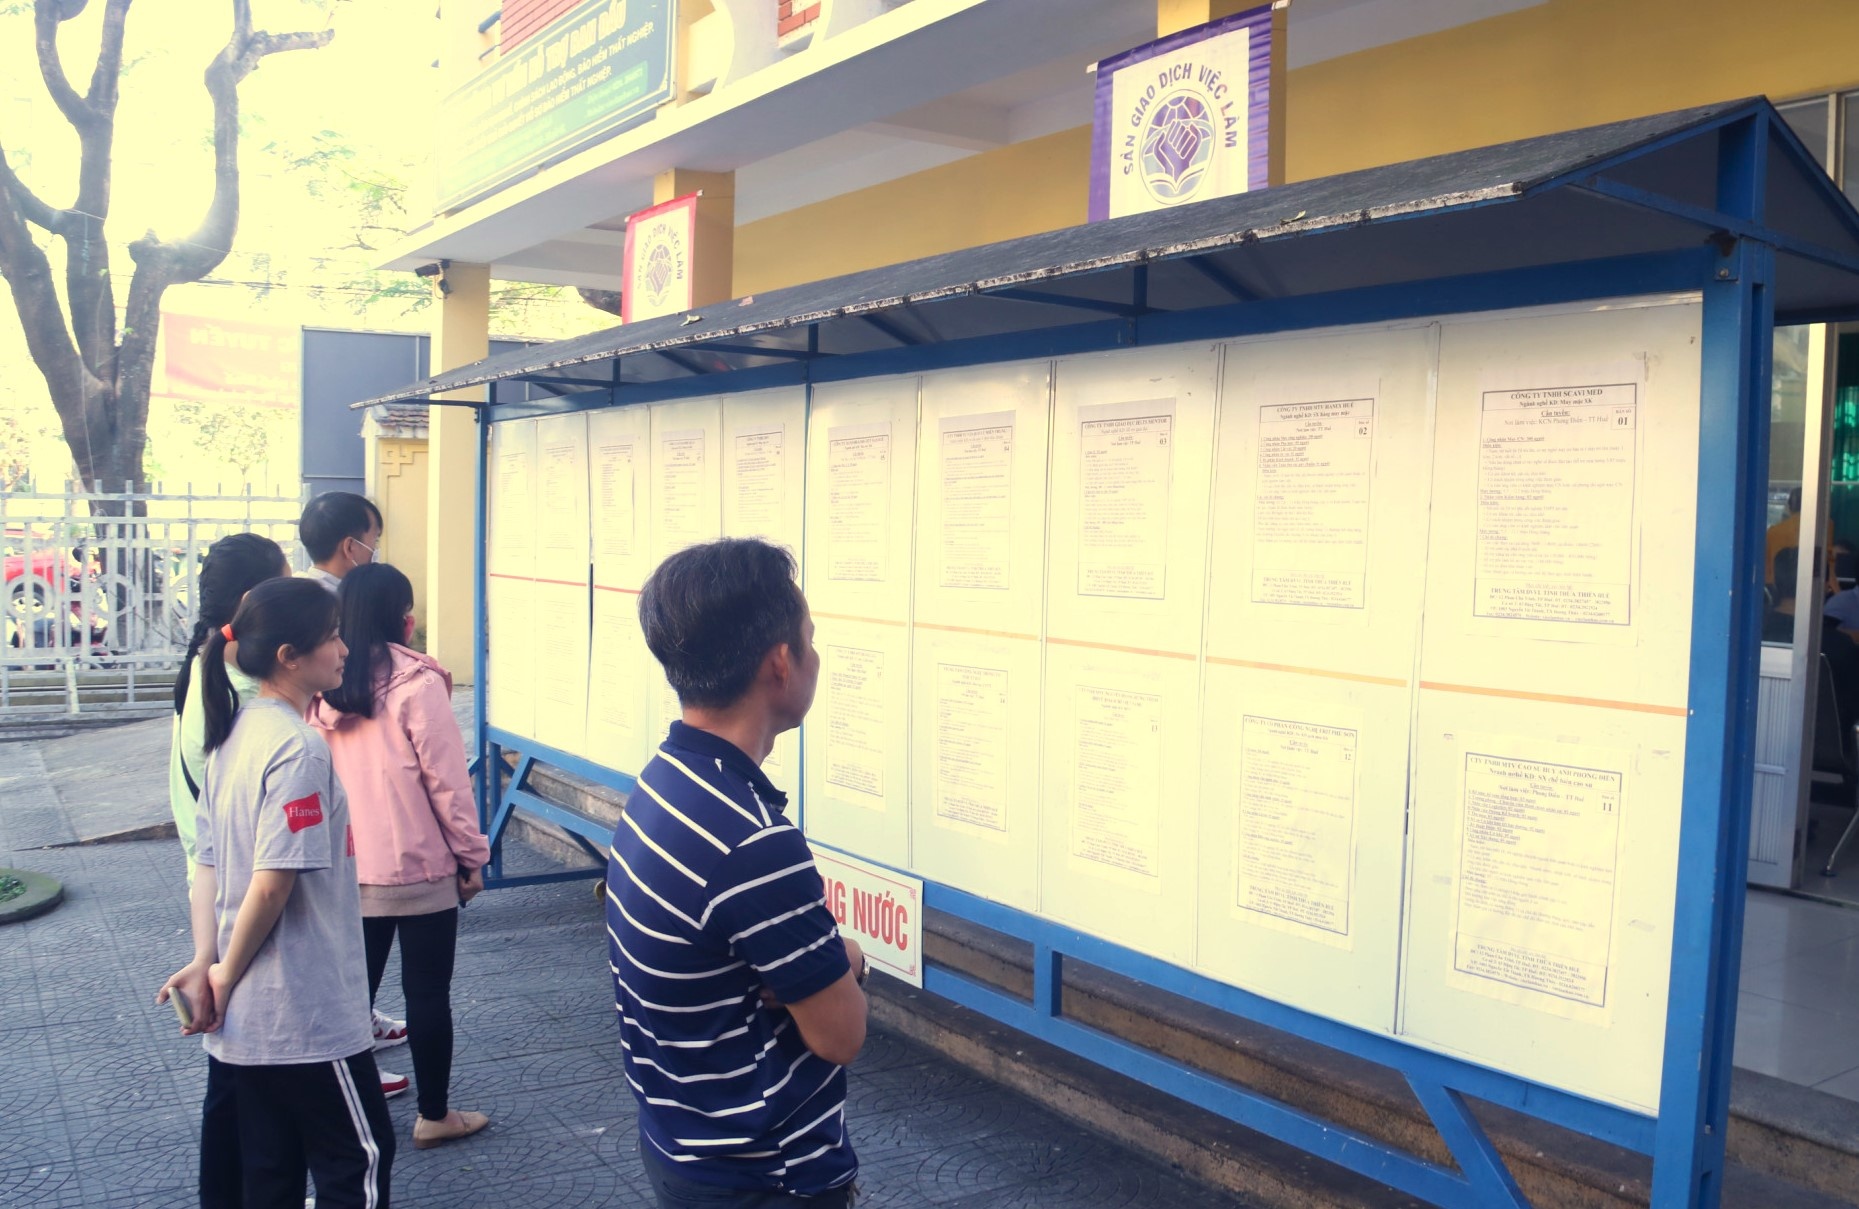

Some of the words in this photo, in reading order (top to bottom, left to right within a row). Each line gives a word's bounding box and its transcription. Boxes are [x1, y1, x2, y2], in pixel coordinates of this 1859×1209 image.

[608, 35, 626, 56] THẤT
[1120, 135, 1136, 175] SÀN
[1132, 85, 1155, 128] GIAO
[1158, 62, 1192, 88] DỊCH
[1198, 64, 1228, 100] VIỆC
[1220, 101, 1240, 148] LÀM
[1618, 416, 1628, 426] 01
[1358, 427, 1368, 435] 02
[288, 806, 320, 818] Hanes
[1603, 802, 1612, 812] 11
[853, 888, 908, 951] NƯỚC
